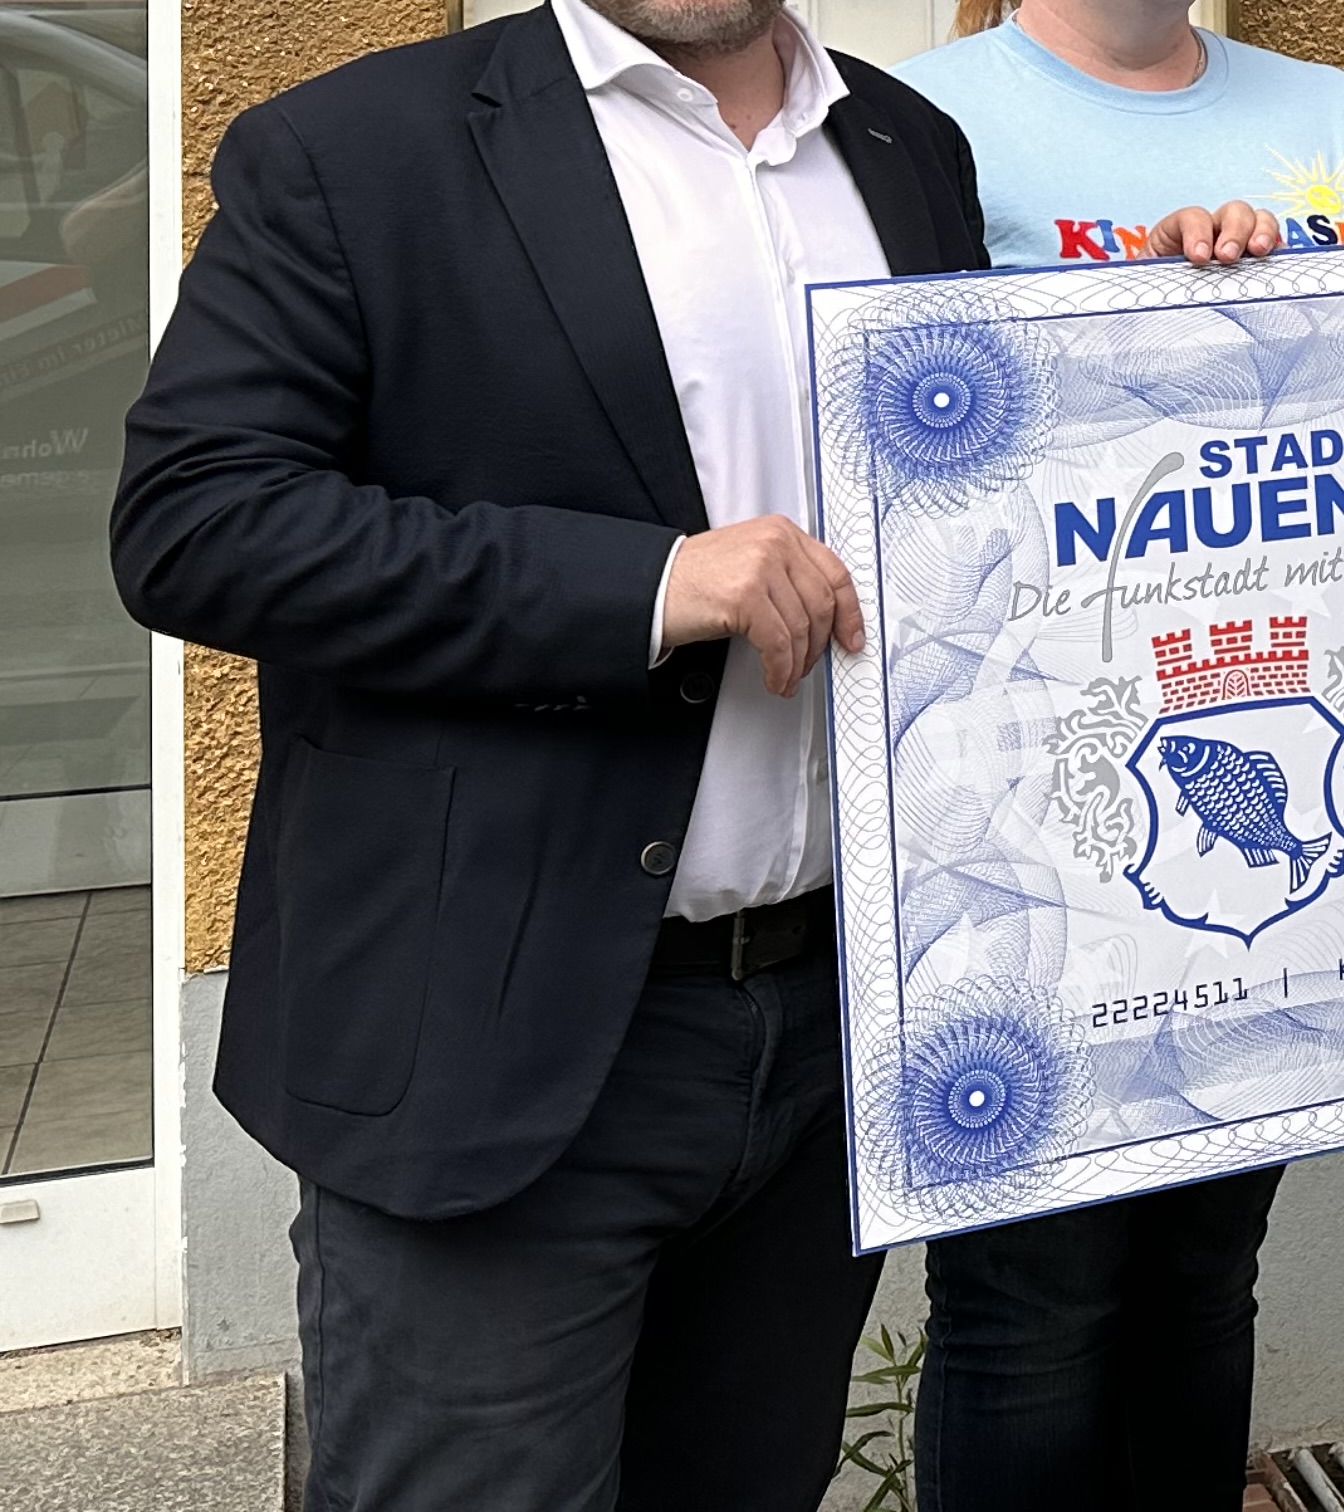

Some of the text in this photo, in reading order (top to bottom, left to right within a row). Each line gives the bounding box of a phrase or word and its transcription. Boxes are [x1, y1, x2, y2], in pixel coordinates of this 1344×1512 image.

[1008, 582, 1071, 621] Die
[1286, 547, 1344, 587] mit
[1092, 977, 1249, 1028] 22224511
